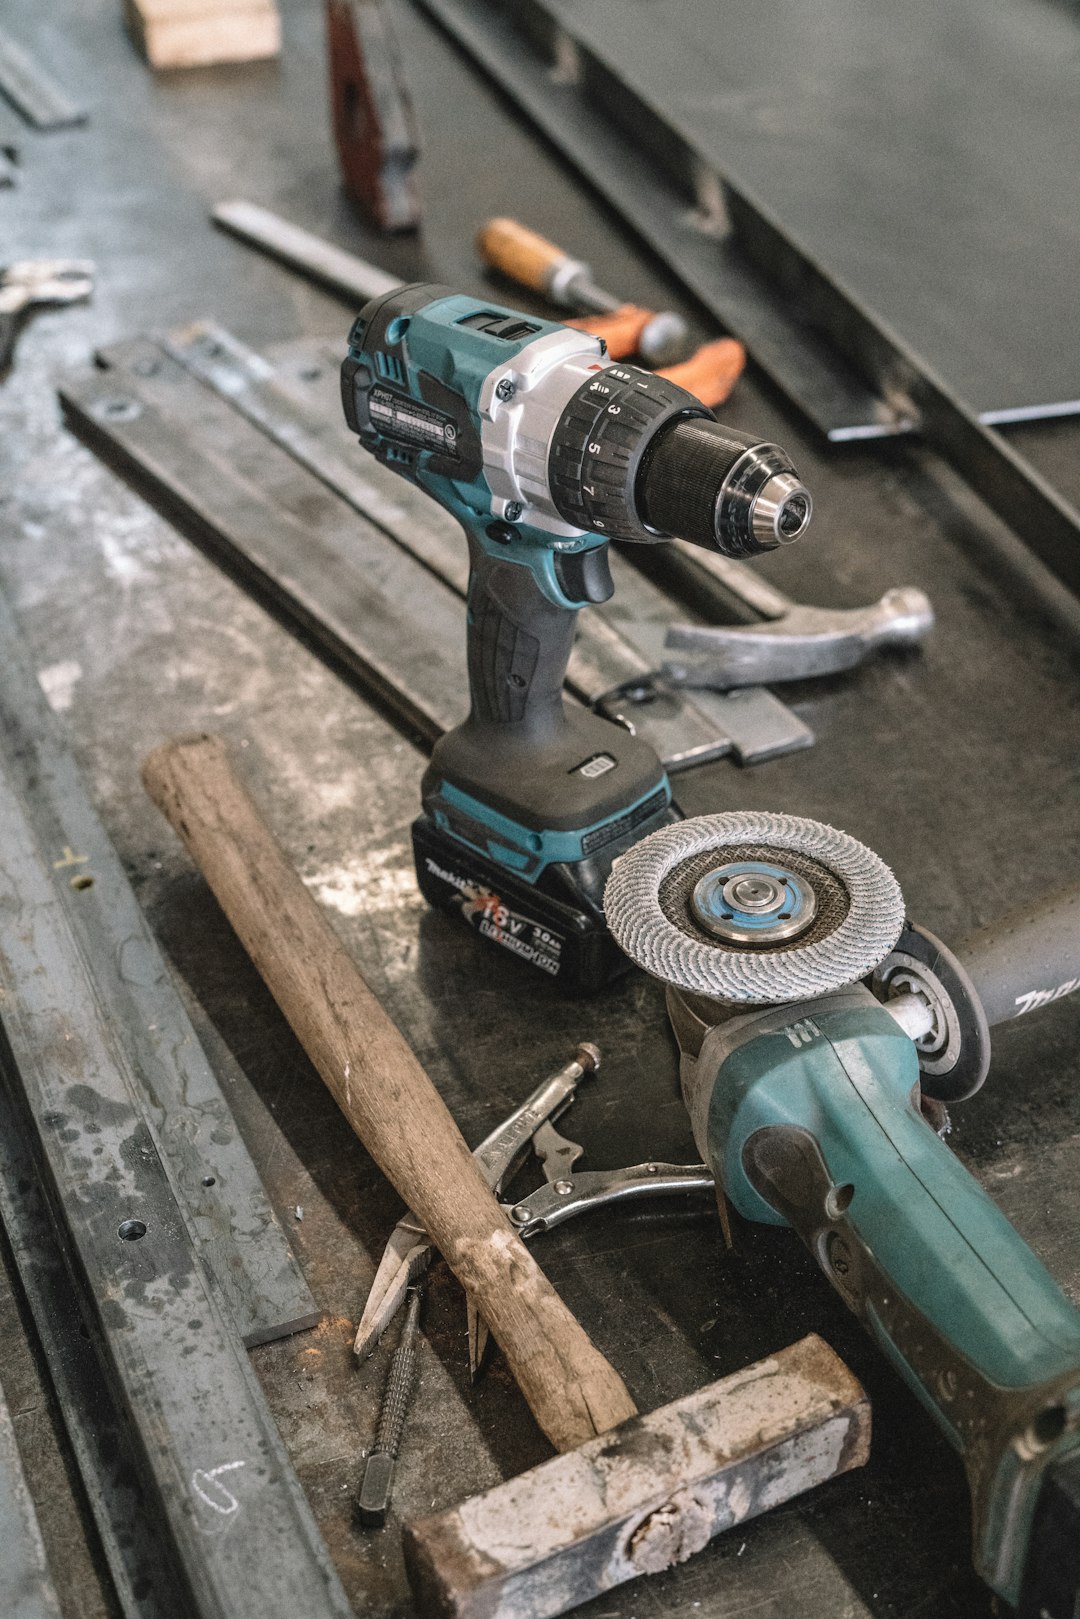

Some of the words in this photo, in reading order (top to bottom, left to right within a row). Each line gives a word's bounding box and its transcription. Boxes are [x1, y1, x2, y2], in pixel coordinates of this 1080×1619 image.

[607, 404, 621, 415] 3
[588, 442, 601, 455] 5
[583, 485, 595, 496] 7
